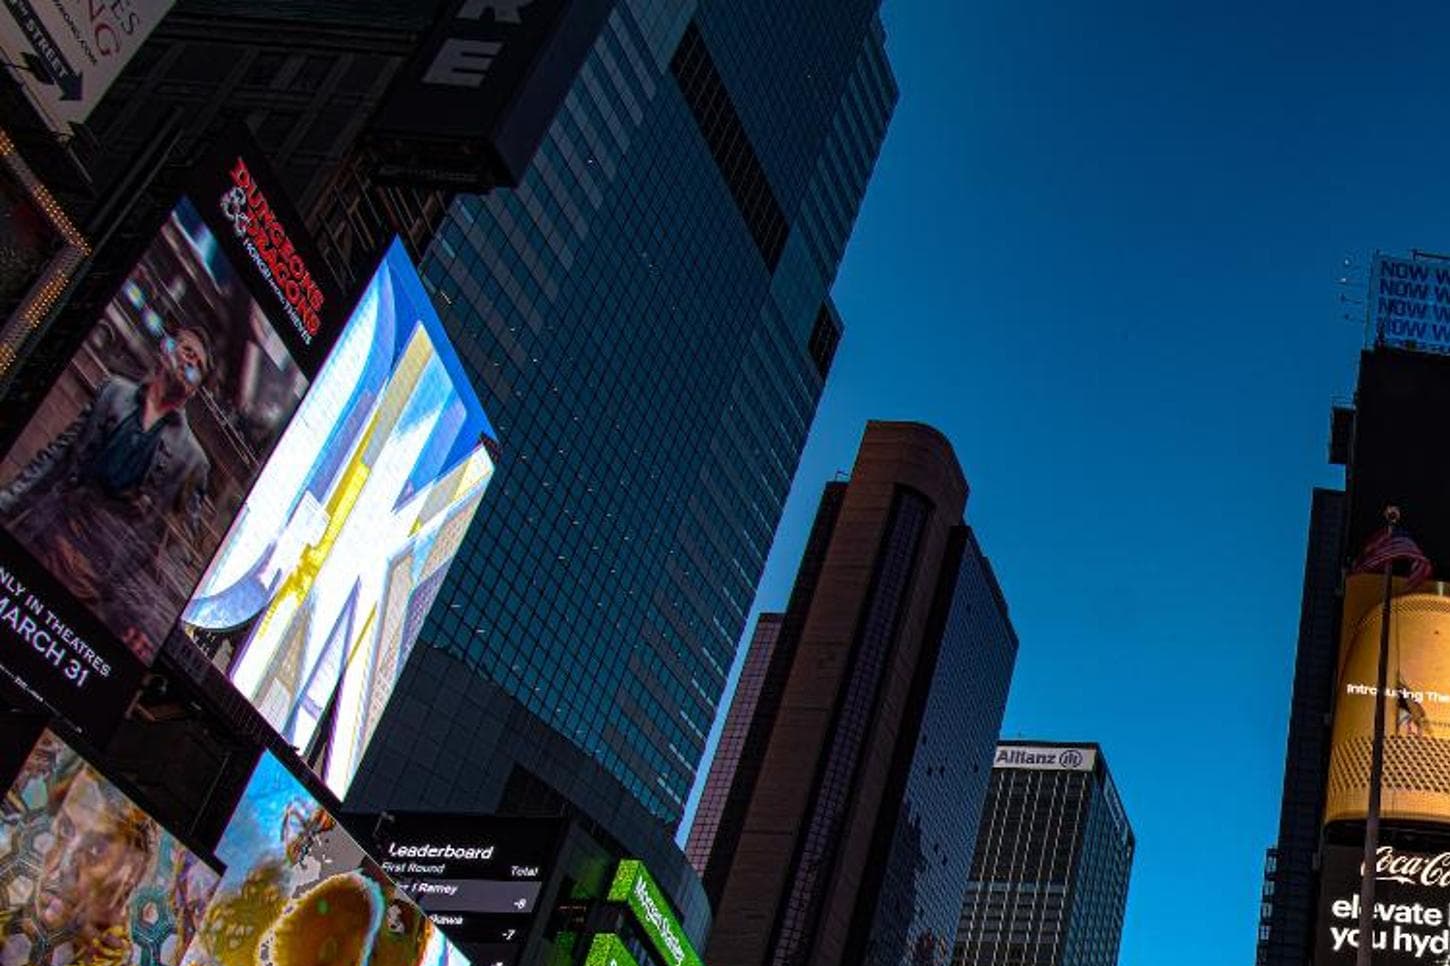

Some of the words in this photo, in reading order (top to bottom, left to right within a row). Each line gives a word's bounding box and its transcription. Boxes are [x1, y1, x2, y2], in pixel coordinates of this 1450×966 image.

[1380, 259, 1430, 280] NOW
[1379, 278, 1429, 299] NOW
[1378, 298, 1428, 319] NOW
[25, 594, 45, 616] IN
[46, 610, 113, 679] THEATRES
[64, 659, 89, 688] 31
[997, 749, 1056, 764] Allianz
[389, 842, 494, 859] Leaderboard
[407, 863, 445, 874] Round
[511, 866, 538, 877] Total
[502, 929, 515, 940] -7
